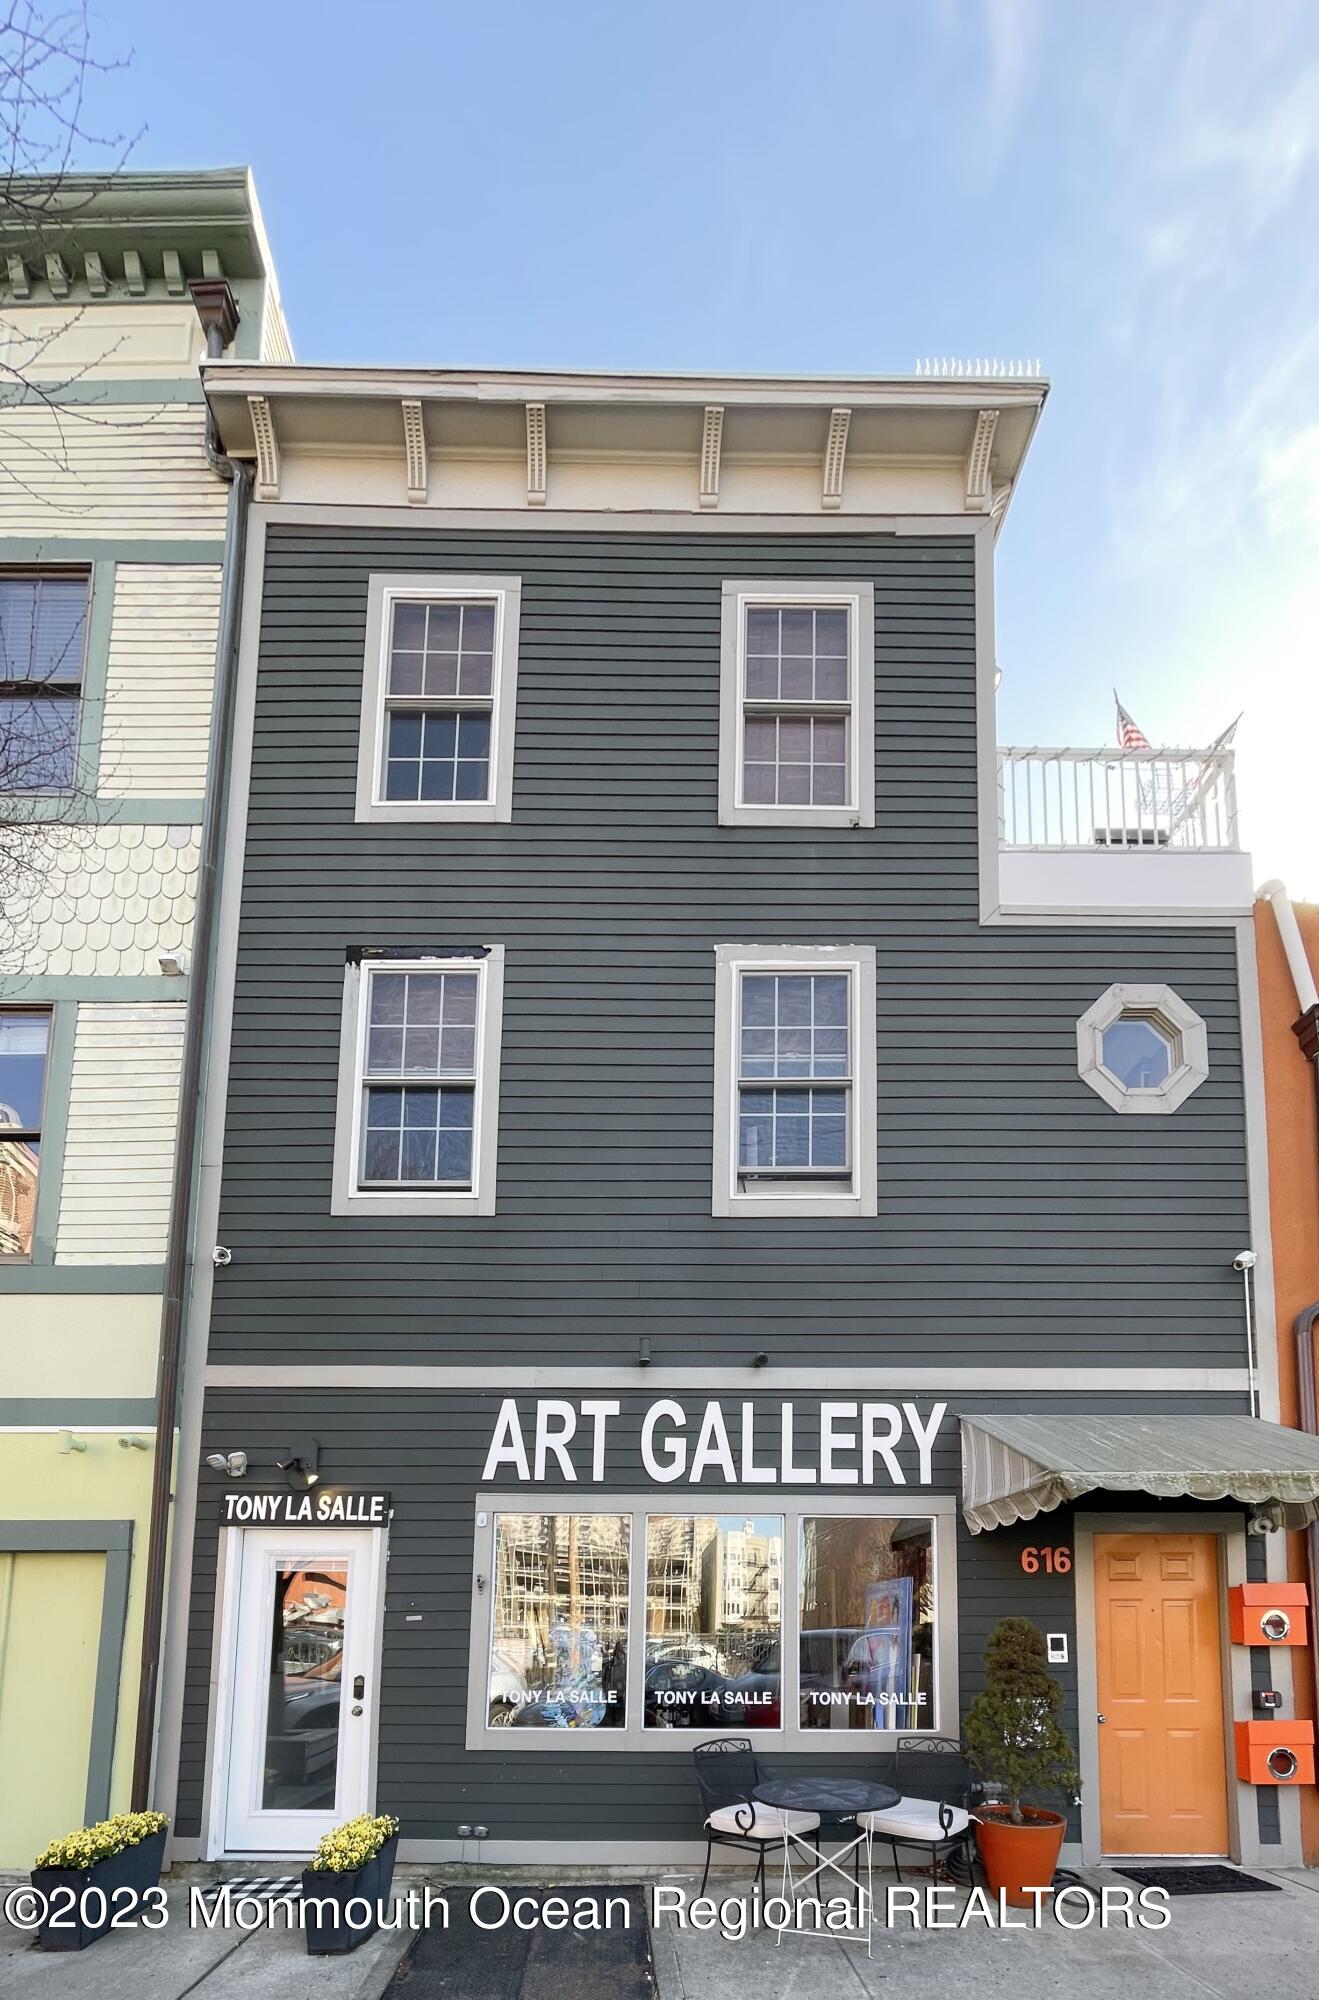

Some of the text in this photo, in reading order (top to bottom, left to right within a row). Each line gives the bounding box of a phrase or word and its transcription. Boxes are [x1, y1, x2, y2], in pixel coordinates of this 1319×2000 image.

[481, 1398, 948, 1485] ART GALLERY
[225, 1494, 384, 1521] TONY LA SALLE
[1021, 1547, 1072, 1573] 616
[501, 1690, 618, 1704] TONY LA SALLE
[654, 1690, 772, 1705] TONY LA SALLE
[810, 1692, 927, 1706] TONY LA SALLE
